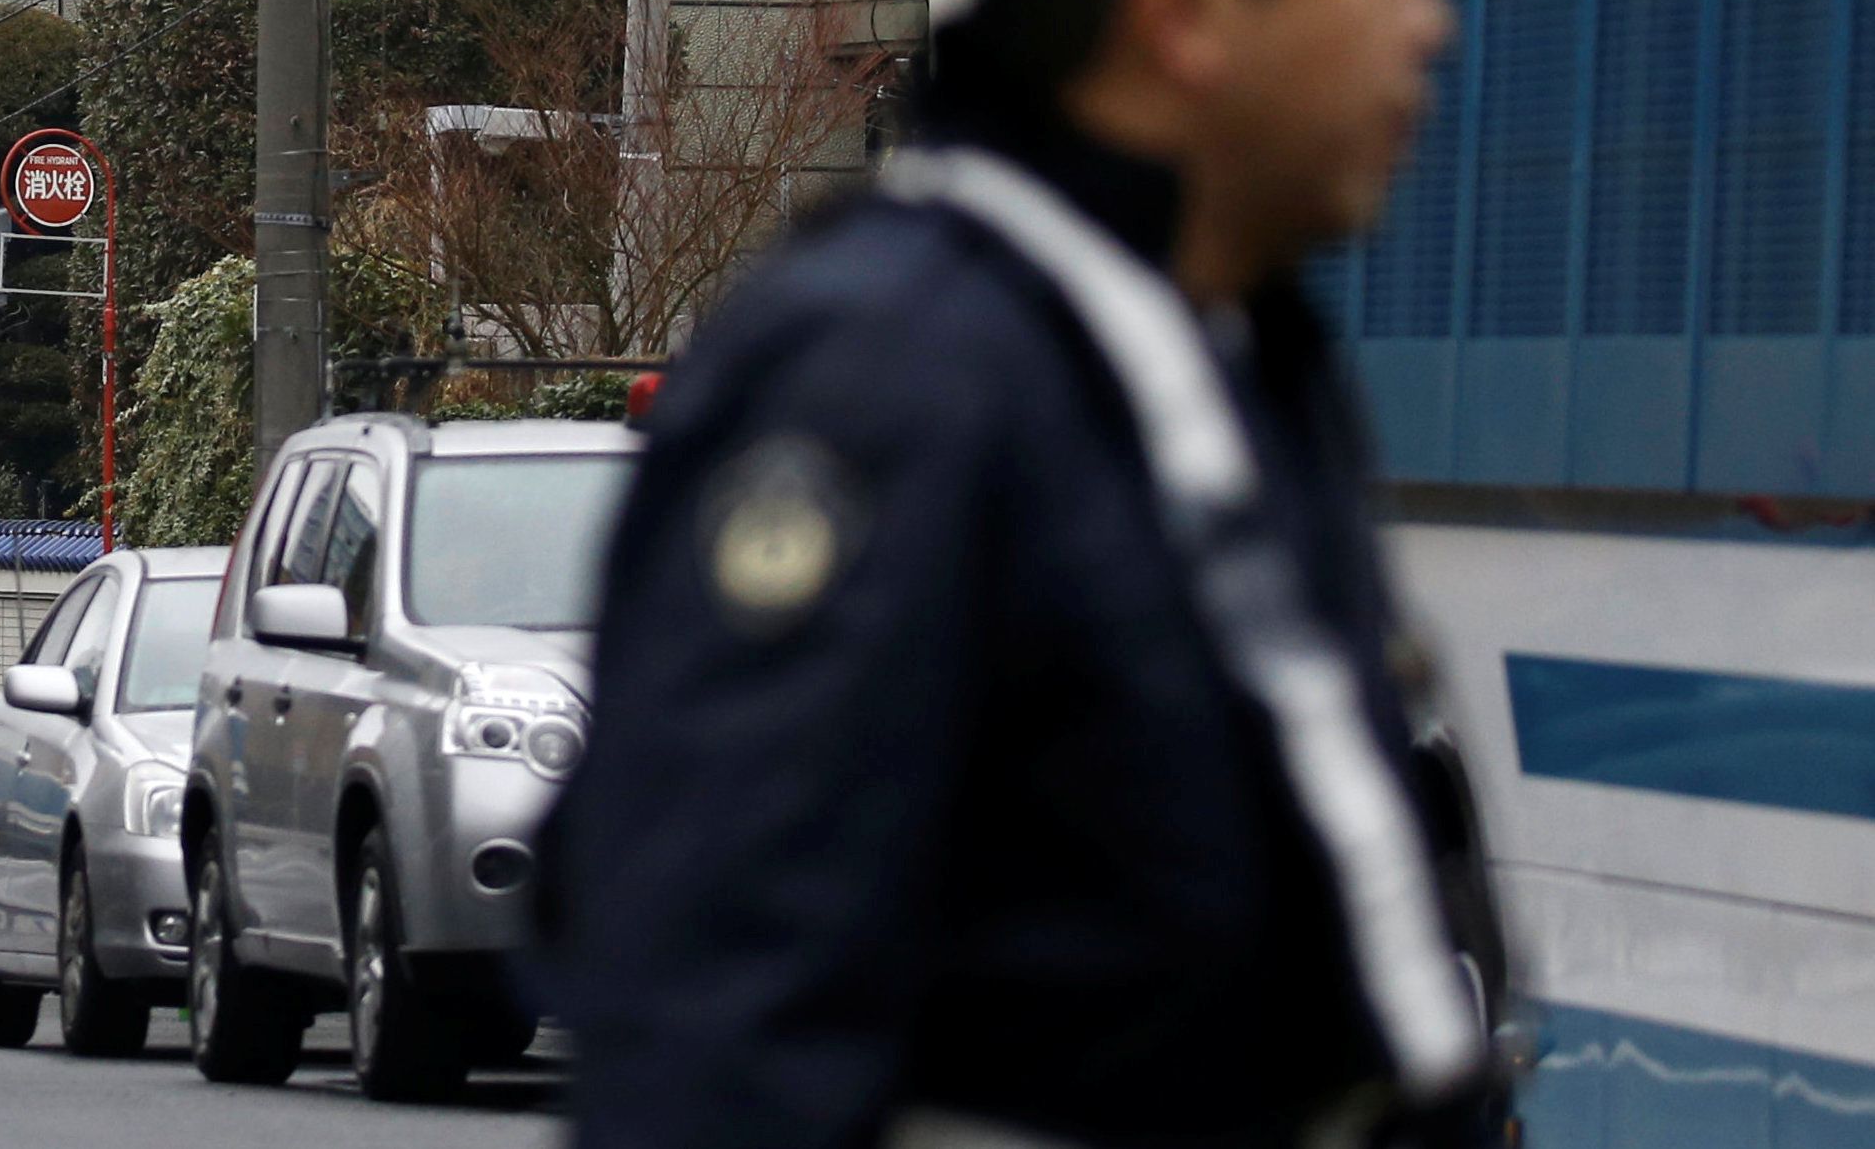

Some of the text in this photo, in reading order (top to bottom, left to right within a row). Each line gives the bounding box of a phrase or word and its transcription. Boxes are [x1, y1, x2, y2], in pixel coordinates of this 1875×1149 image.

[29, 155, 79, 166] FIRE HYDRANT
[24, 169, 87, 201] 消火栓
